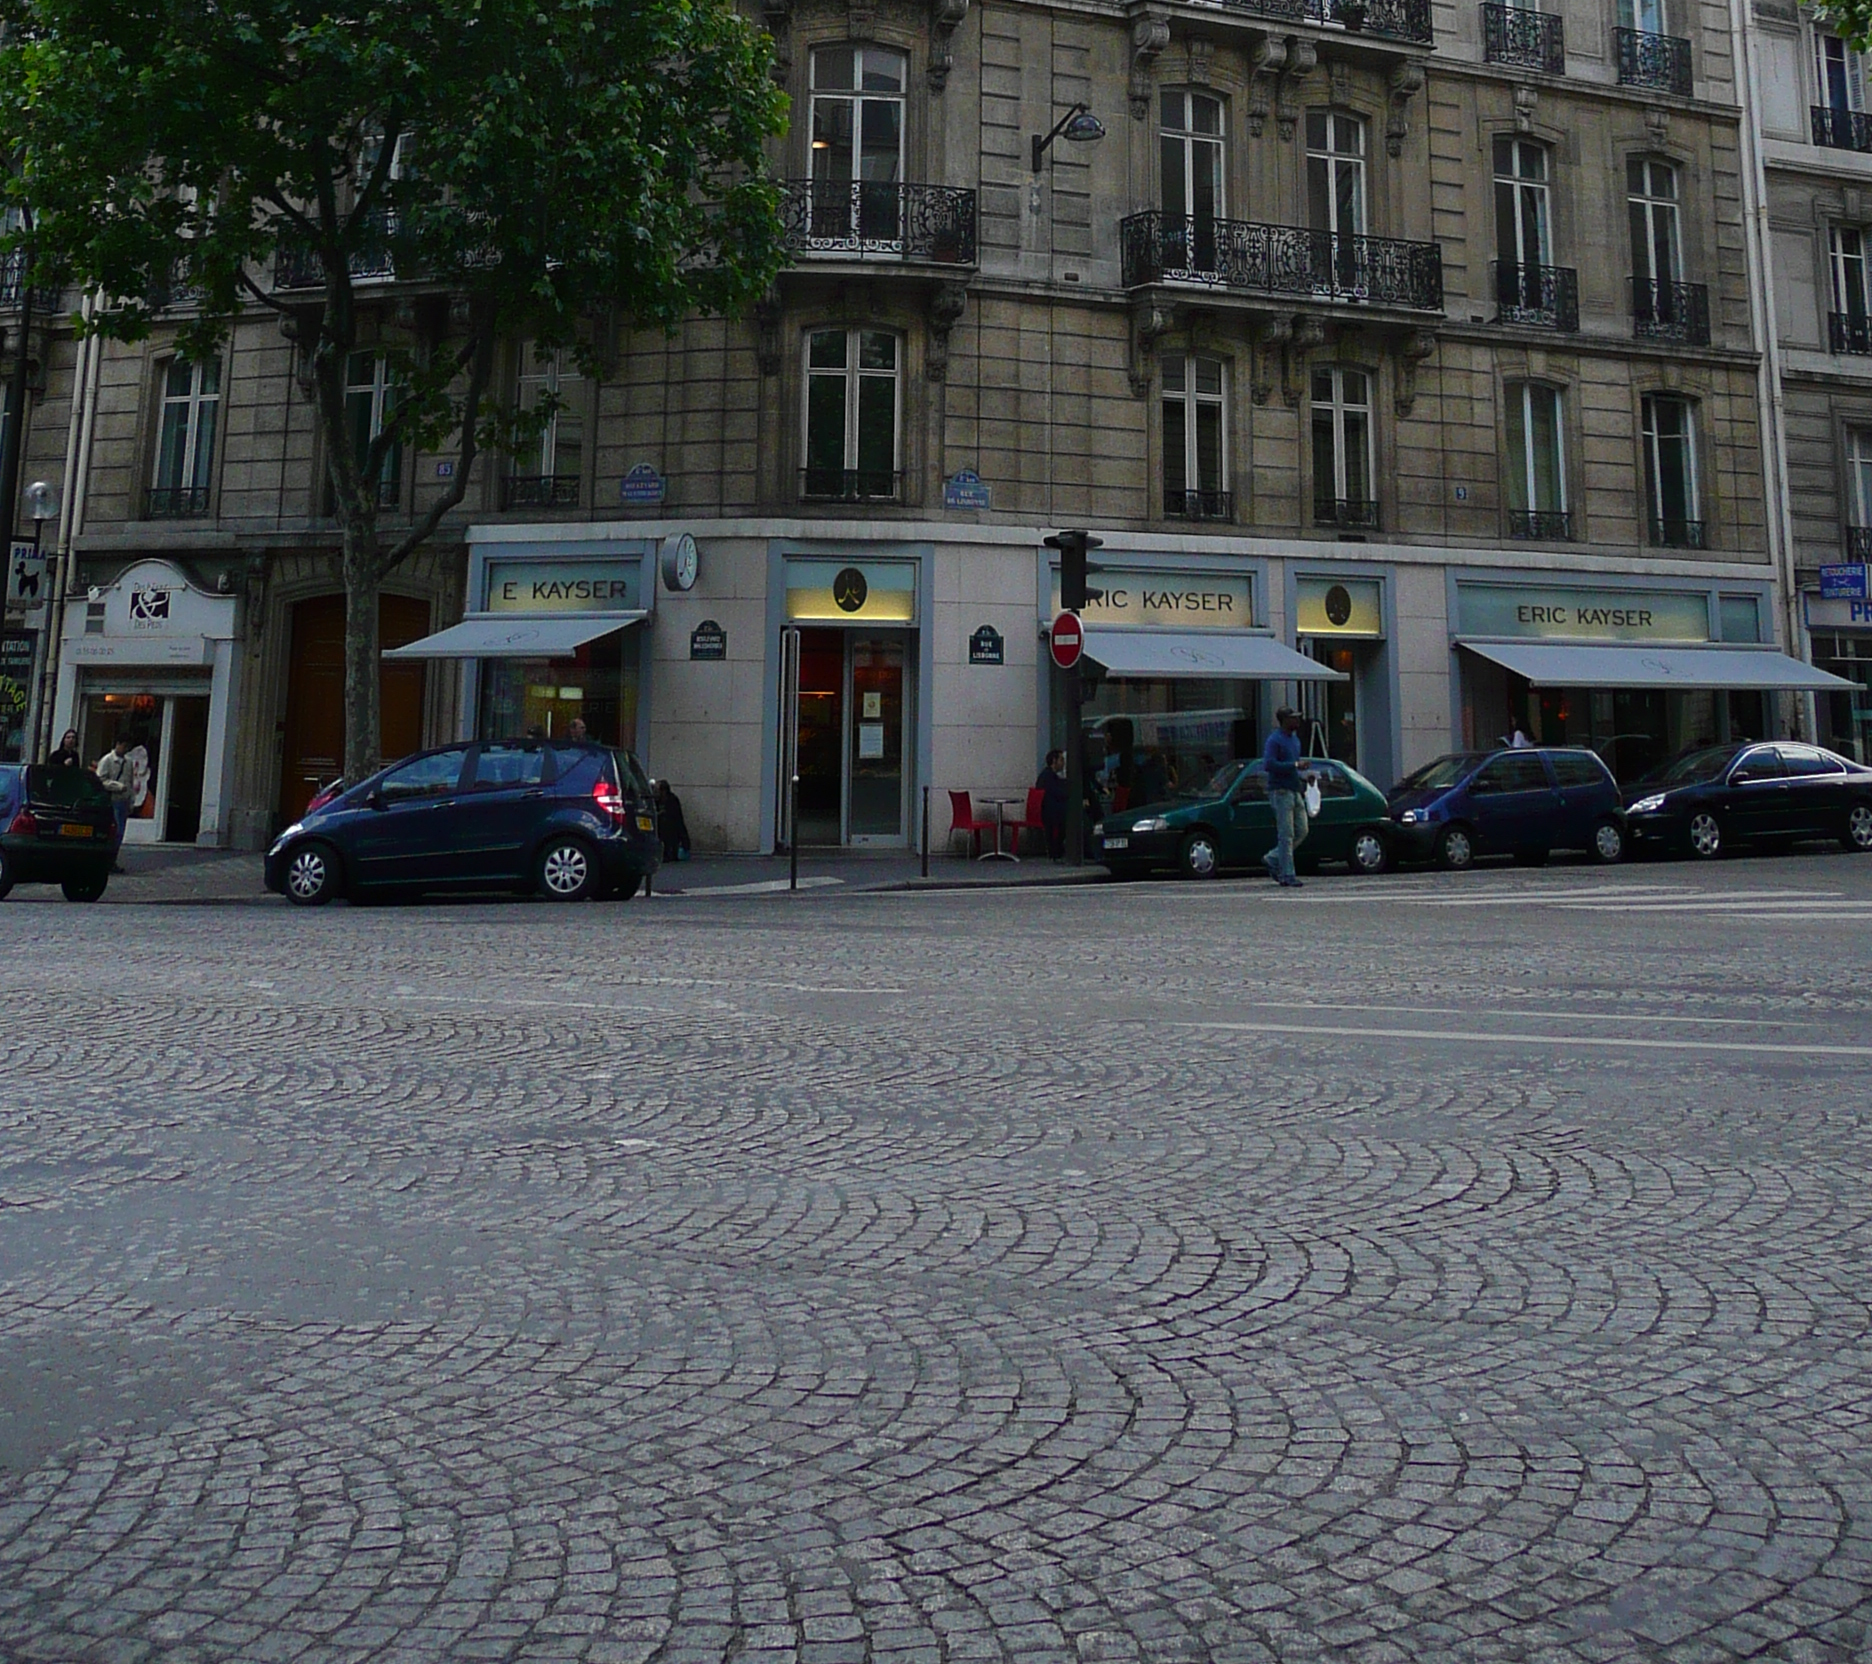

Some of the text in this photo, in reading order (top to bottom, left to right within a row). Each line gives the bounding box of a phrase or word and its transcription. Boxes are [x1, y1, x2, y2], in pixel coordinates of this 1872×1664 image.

[1458, 488, 1465, 499] 9
[1821, 566, 1863, 577] RETOUCHERIE
[502, 580, 627, 600] E KAYSER
[1086, 589, 1233, 611] RIC KAYSER
[1517, 605, 1652, 627] ERIC KAYSER
